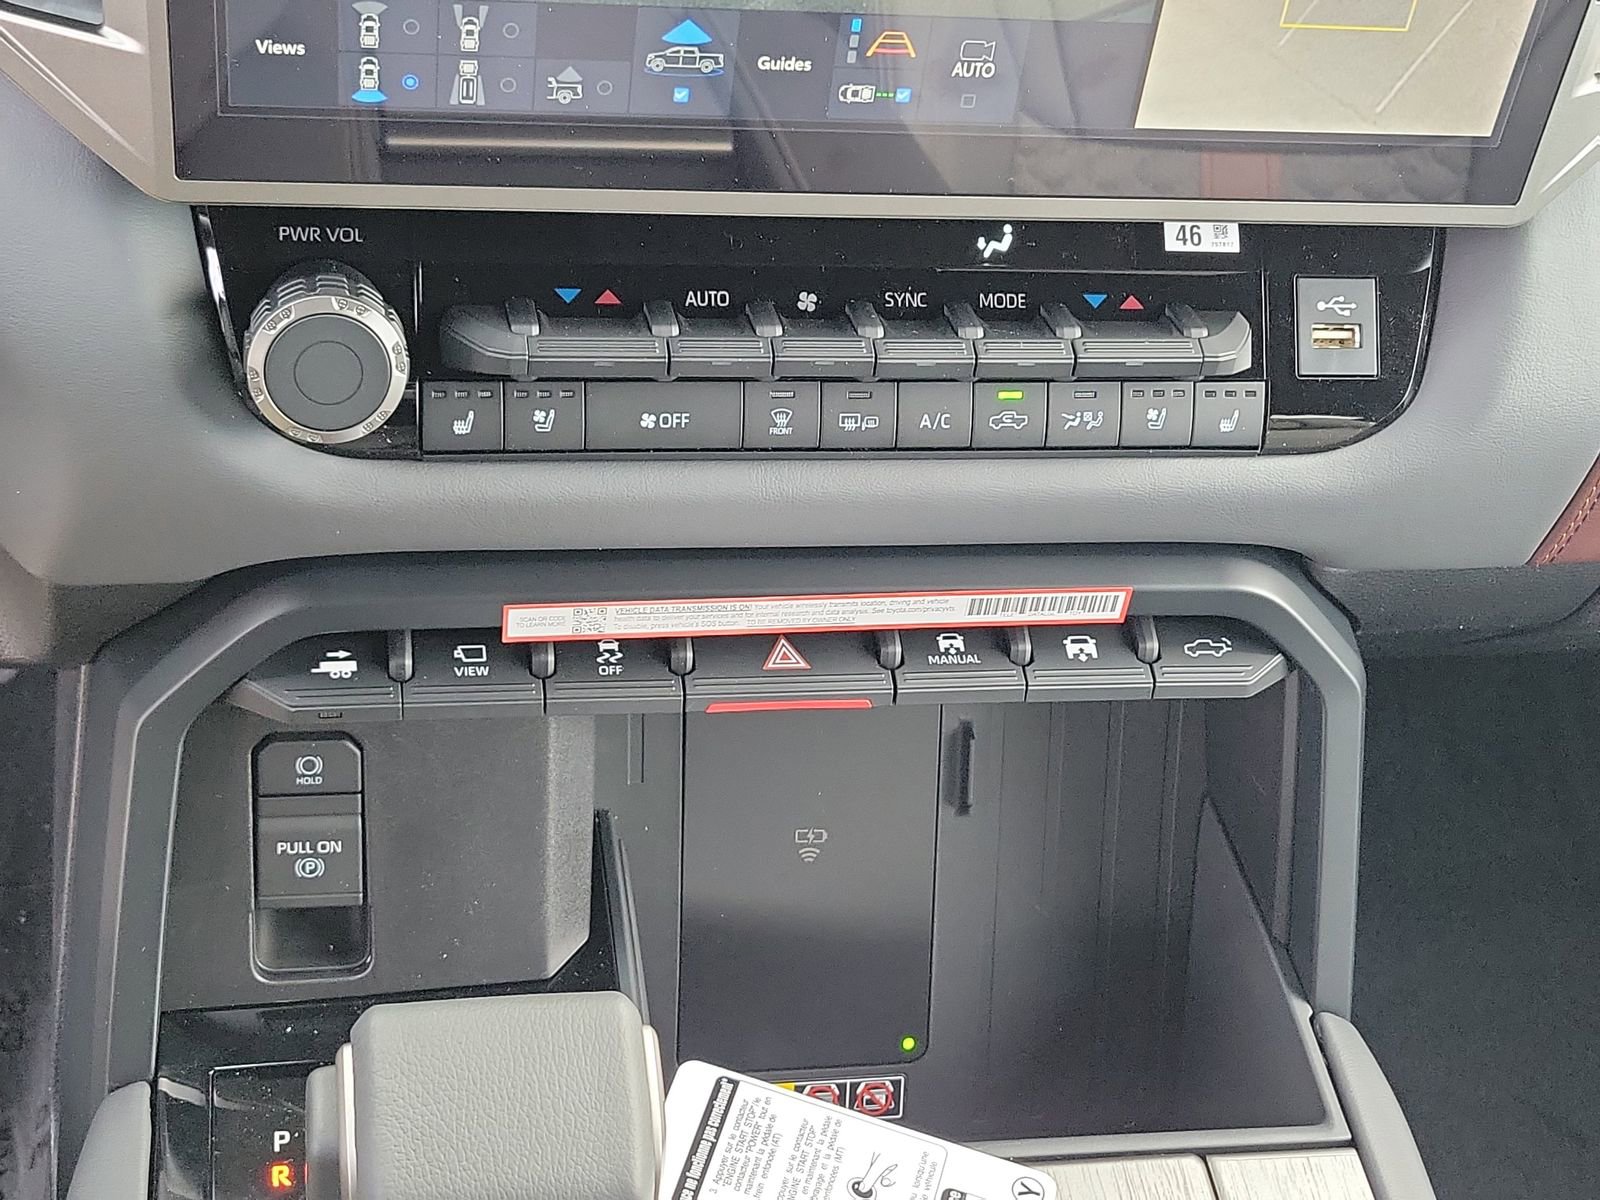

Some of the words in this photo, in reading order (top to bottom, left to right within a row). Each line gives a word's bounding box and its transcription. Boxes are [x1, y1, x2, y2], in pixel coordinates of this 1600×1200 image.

[255, 39, 306, 56] Views
[757, 56, 812, 73] Guides
[951, 60, 996, 79] AUTO
[278, 226, 321, 243] PWR
[326, 226, 363, 243] VOL
[1175, 224, 1202, 246] 46
[685, 290, 729, 307] AUTO
[884, 292, 927, 309] SYNC
[978, 292, 1026, 310] MODE
[658, 412, 691, 429] OFF
[919, 411, 952, 430] A/C
[769, 425, 793, 436] FRONT
[672, 604, 728, 612] TRANSMISSION
[928, 653, 982, 666] MANUAL
[454, 666, 490, 678] VIEW
[598, 666, 624, 676] OFF
[296, 776, 322, 786] HOLD
[276, 841, 313, 854] PULL
[316, 840, 342, 854] ON
[769, 1114, 776, 1123] de
[274, 1131, 290, 1152] P
[702, 1126, 717, 1142] pas
[734, 1130, 749, 1154] START
[686, 1140, 712, 1179] fonctionne
[796, 1149, 810, 1174] START
[272, 1164, 292, 1188] R
[684, 1178, 698, 1190] ne
